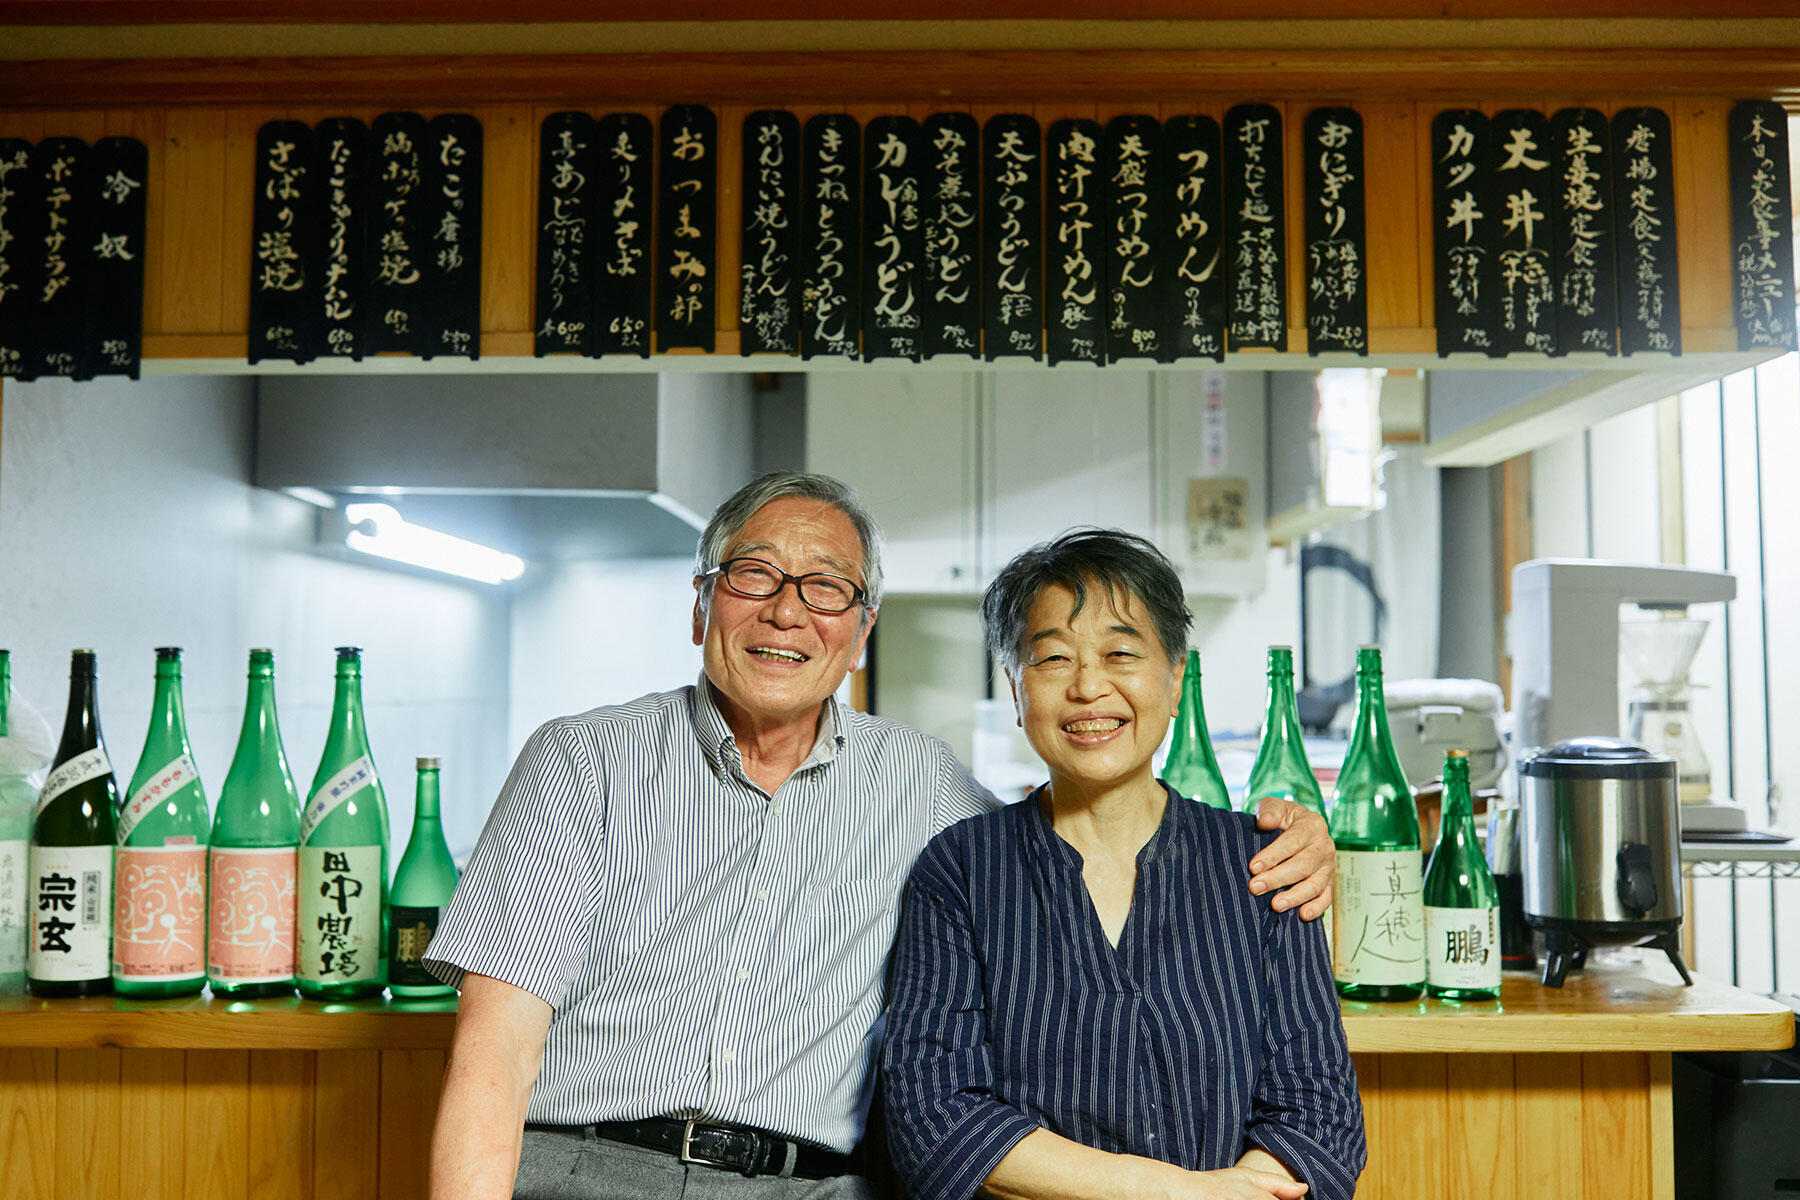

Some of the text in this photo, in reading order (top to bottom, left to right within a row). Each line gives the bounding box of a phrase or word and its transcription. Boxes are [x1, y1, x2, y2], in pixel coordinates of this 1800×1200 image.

[43, 157, 75, 301] ポテトサラダ
[94, 171, 140, 260] 冷奴
[259, 141, 305, 291] さばの塩焼
[325, 140, 352, 320] たこきゅうりのナムル
[434, 135, 465, 270] たこの唐揚
[670, 127, 706, 323] おつまみの部
[815, 126, 851, 342] きつねとろろうどん
[872, 131, 916, 316] カレーうどん
[932, 127, 977, 305] みそ煮込うどん
[994, 129, 1037, 293] 天ぷらうどん
[1057, 130, 1098, 305] 肉汁つけめん
[1110, 132, 1154, 288] 天盛つけめん
[1175, 148, 1220, 283] つけめん
[1239, 120, 1273, 222] 打ちたて麺
[1316, 118, 1356, 239] おにぎり
[1439, 122, 1485, 244] カツ丼
[1496, 127, 1551, 251] 天丼
[1562, 125, 1606, 266] 生姜焼定食
[1623, 122, 1664, 242] 唐揚定食
[1742, 112, 1785, 321] 本日のお食事メニュー
[328, 329, 353, 344] 650
[610, 317, 644, 333] 650
[38, 873, 76, 953] 宗玄
[1445, 922, 1490, 965] 鵬
